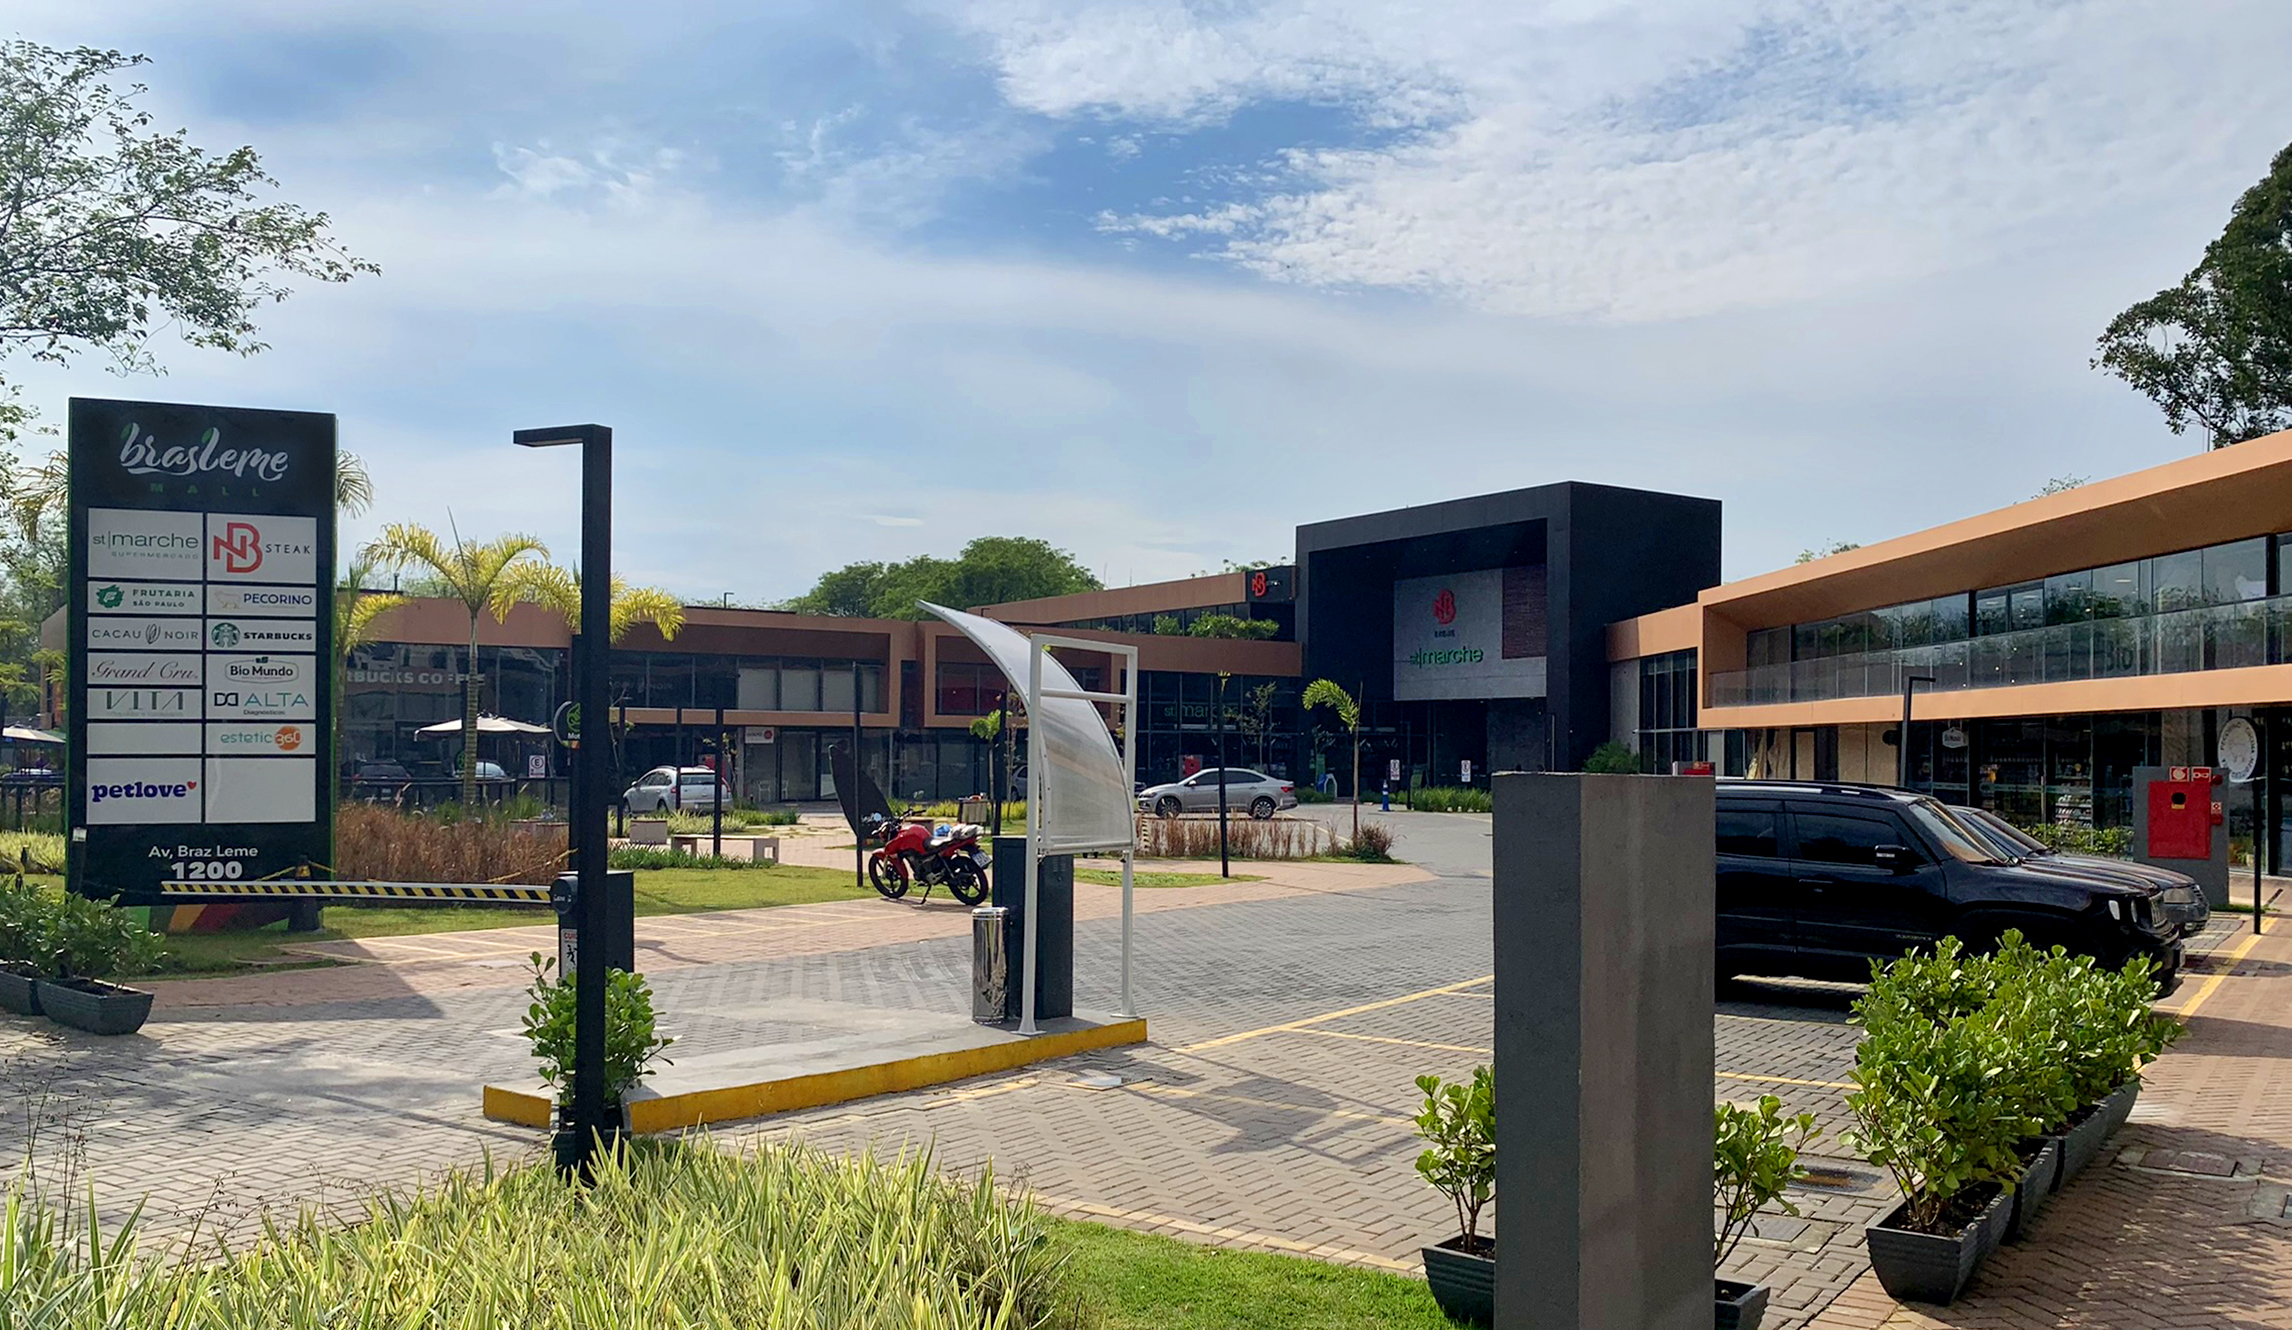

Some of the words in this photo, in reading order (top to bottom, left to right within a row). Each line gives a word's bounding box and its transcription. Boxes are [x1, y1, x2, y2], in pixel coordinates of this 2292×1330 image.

[151, 483, 260, 497] MALL
[265, 543, 312, 555] STEAK
[132, 588, 196, 599] FRUTARIA
[243, 593, 313, 605] PECORINO
[132, 599, 151, 608] SÃO
[92, 628, 142, 640] CACAU
[164, 630, 199, 641] NOIR
[243, 631, 313, 641] STARBUCKS
[92, 660, 156, 679] Grand
[230, 665, 250, 676] Bio
[252, 665, 294, 676] Mundo
[106, 691, 184, 710] VITA
[244, 692, 309, 707] ALTA
[91, 781, 187, 803] petlove
[178, 846, 212, 857] Braz
[216, 846, 259, 857] Leme
[171, 861, 243, 880] 1200
